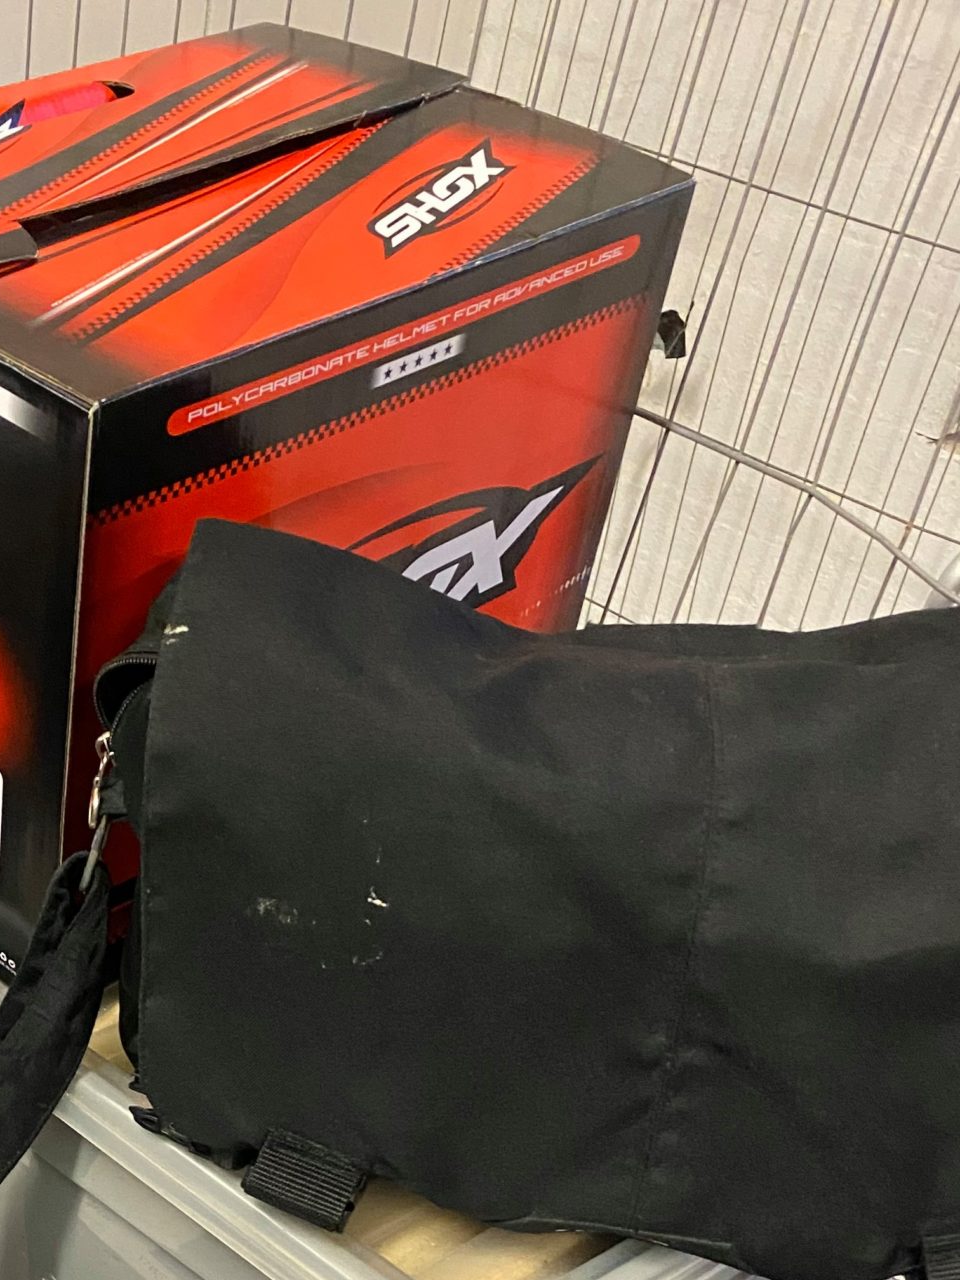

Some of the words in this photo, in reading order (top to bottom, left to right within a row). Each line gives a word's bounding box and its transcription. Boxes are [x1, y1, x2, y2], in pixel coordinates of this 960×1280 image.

[375, 148, 507, 248] SHOX
[187, 344, 370, 423] POLYCARBONATE
[372, 312, 451, 354] HELMET
[453, 296, 492, 322] FOR
[494, 262, 587, 306] ADVANCED
[589, 246, 625, 270] USE
